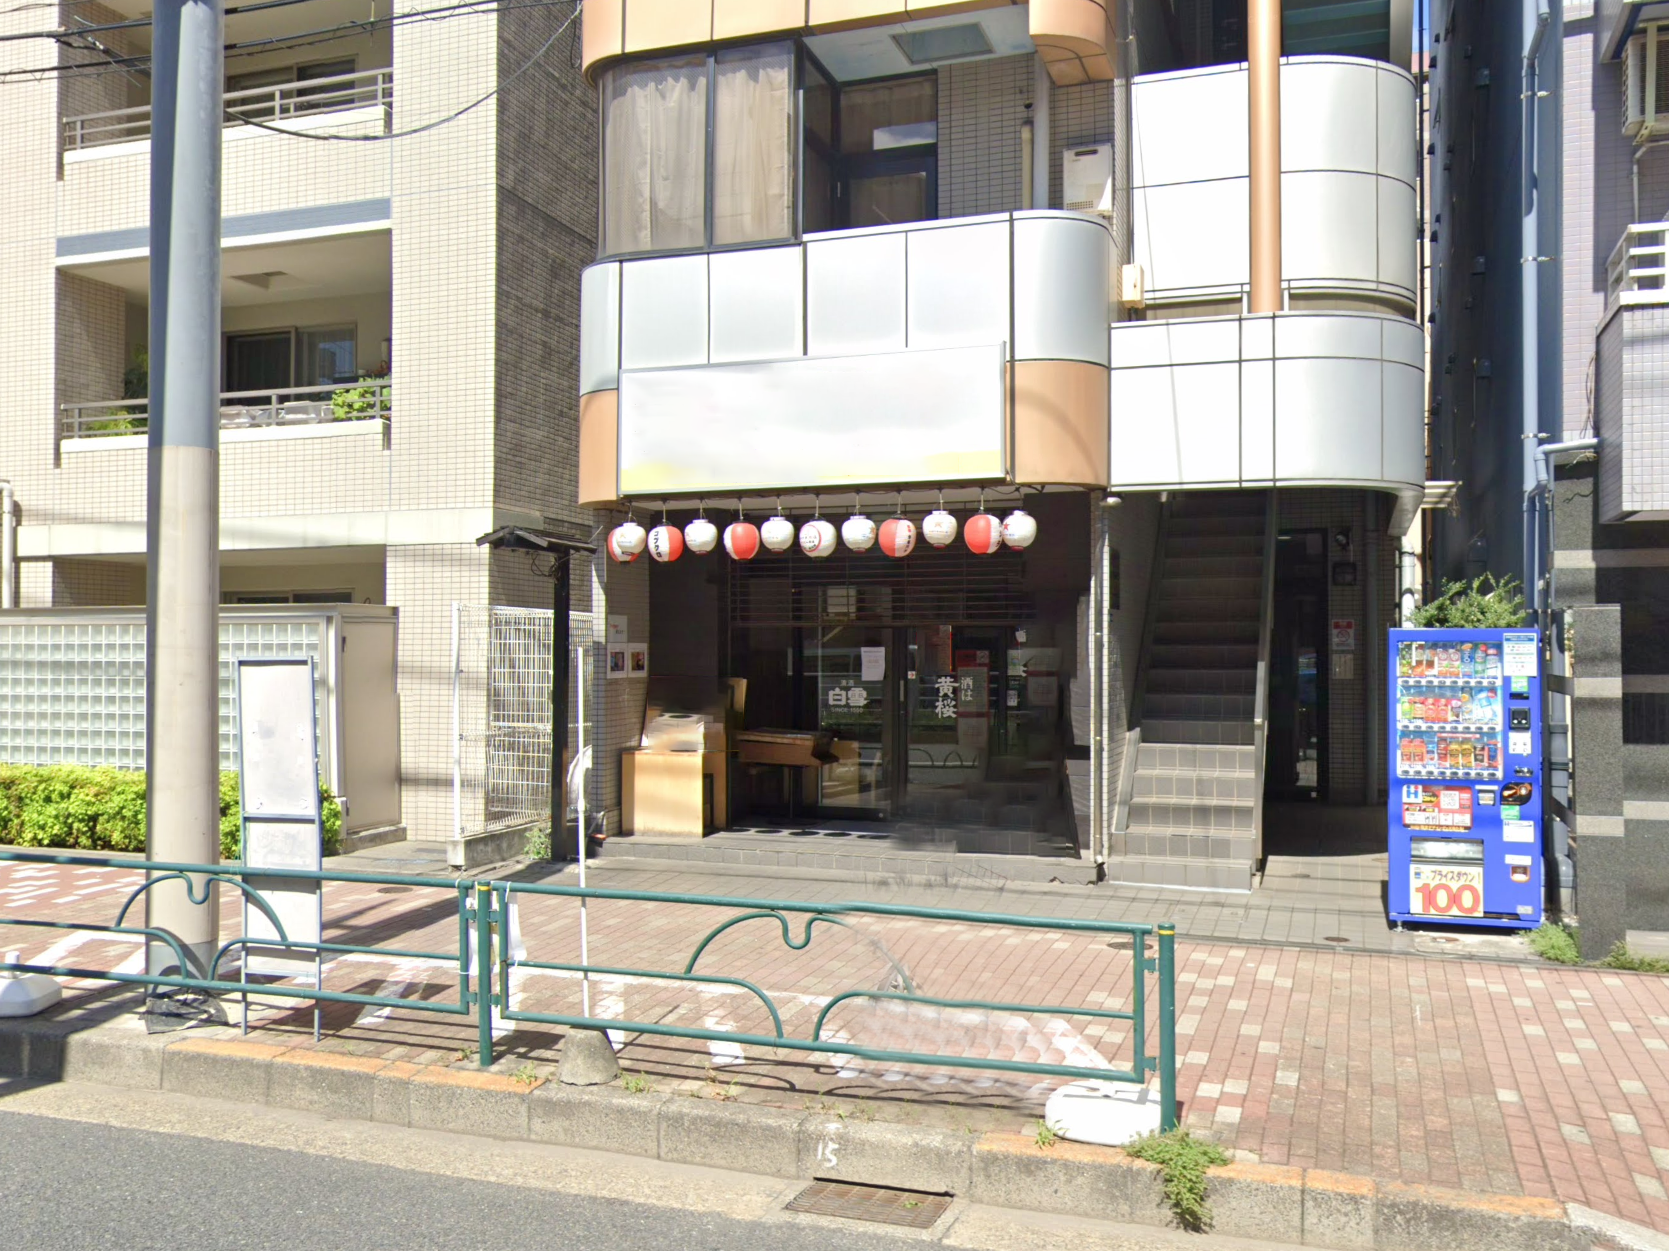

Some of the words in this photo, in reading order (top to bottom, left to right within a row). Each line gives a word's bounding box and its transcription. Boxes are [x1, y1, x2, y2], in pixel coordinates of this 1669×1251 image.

[828, 687, 871, 707] 白雪
[934, 676, 961, 719] 黄桜
[960, 676, 974, 701] 酒は
[1415, 883, 1481, 915] 100
[816, 1140, 839, 1168] 15
